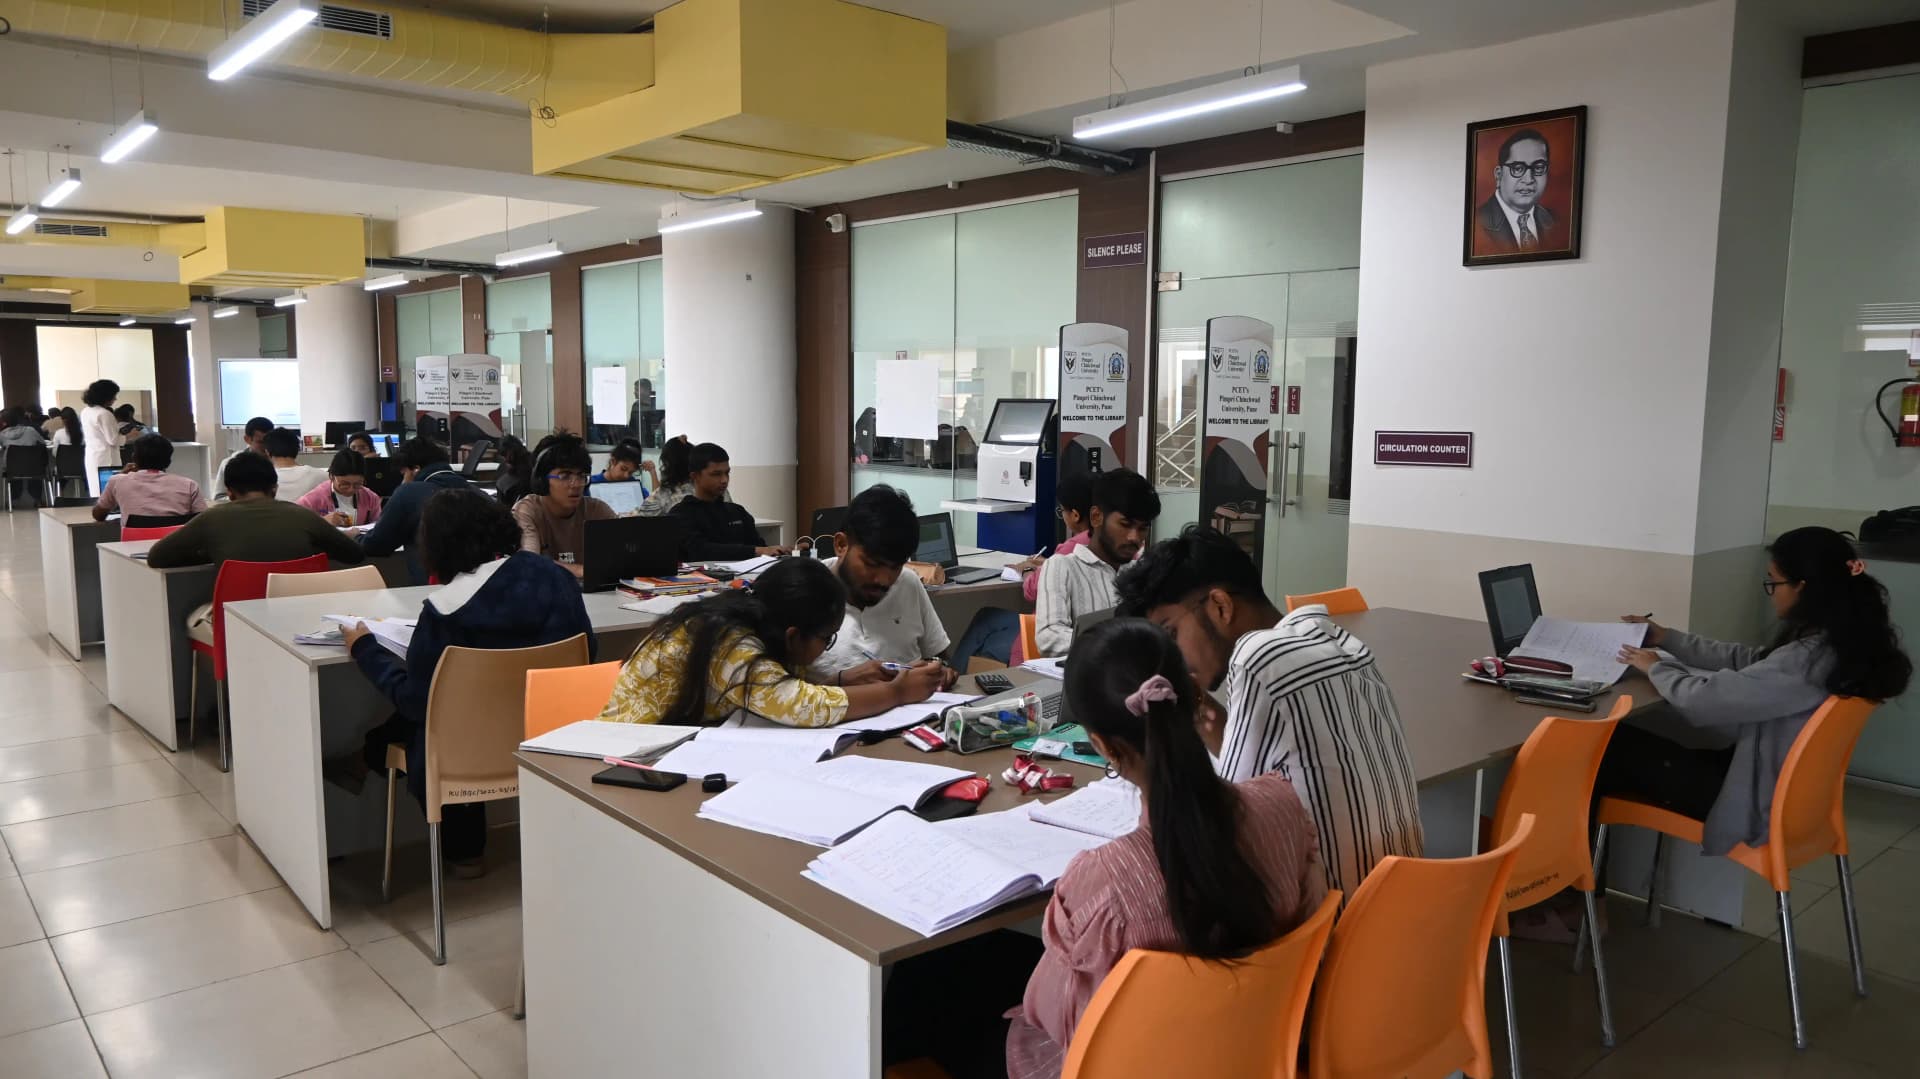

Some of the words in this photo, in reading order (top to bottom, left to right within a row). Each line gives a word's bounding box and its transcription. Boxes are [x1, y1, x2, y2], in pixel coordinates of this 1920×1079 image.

[1087, 245, 1115, 258] SILENCE
[1116, 243, 1142, 256] PLEASE
[1379, 443, 1428, 453] CIRCULATION
[1429, 445, 1466, 454] COUNTER
